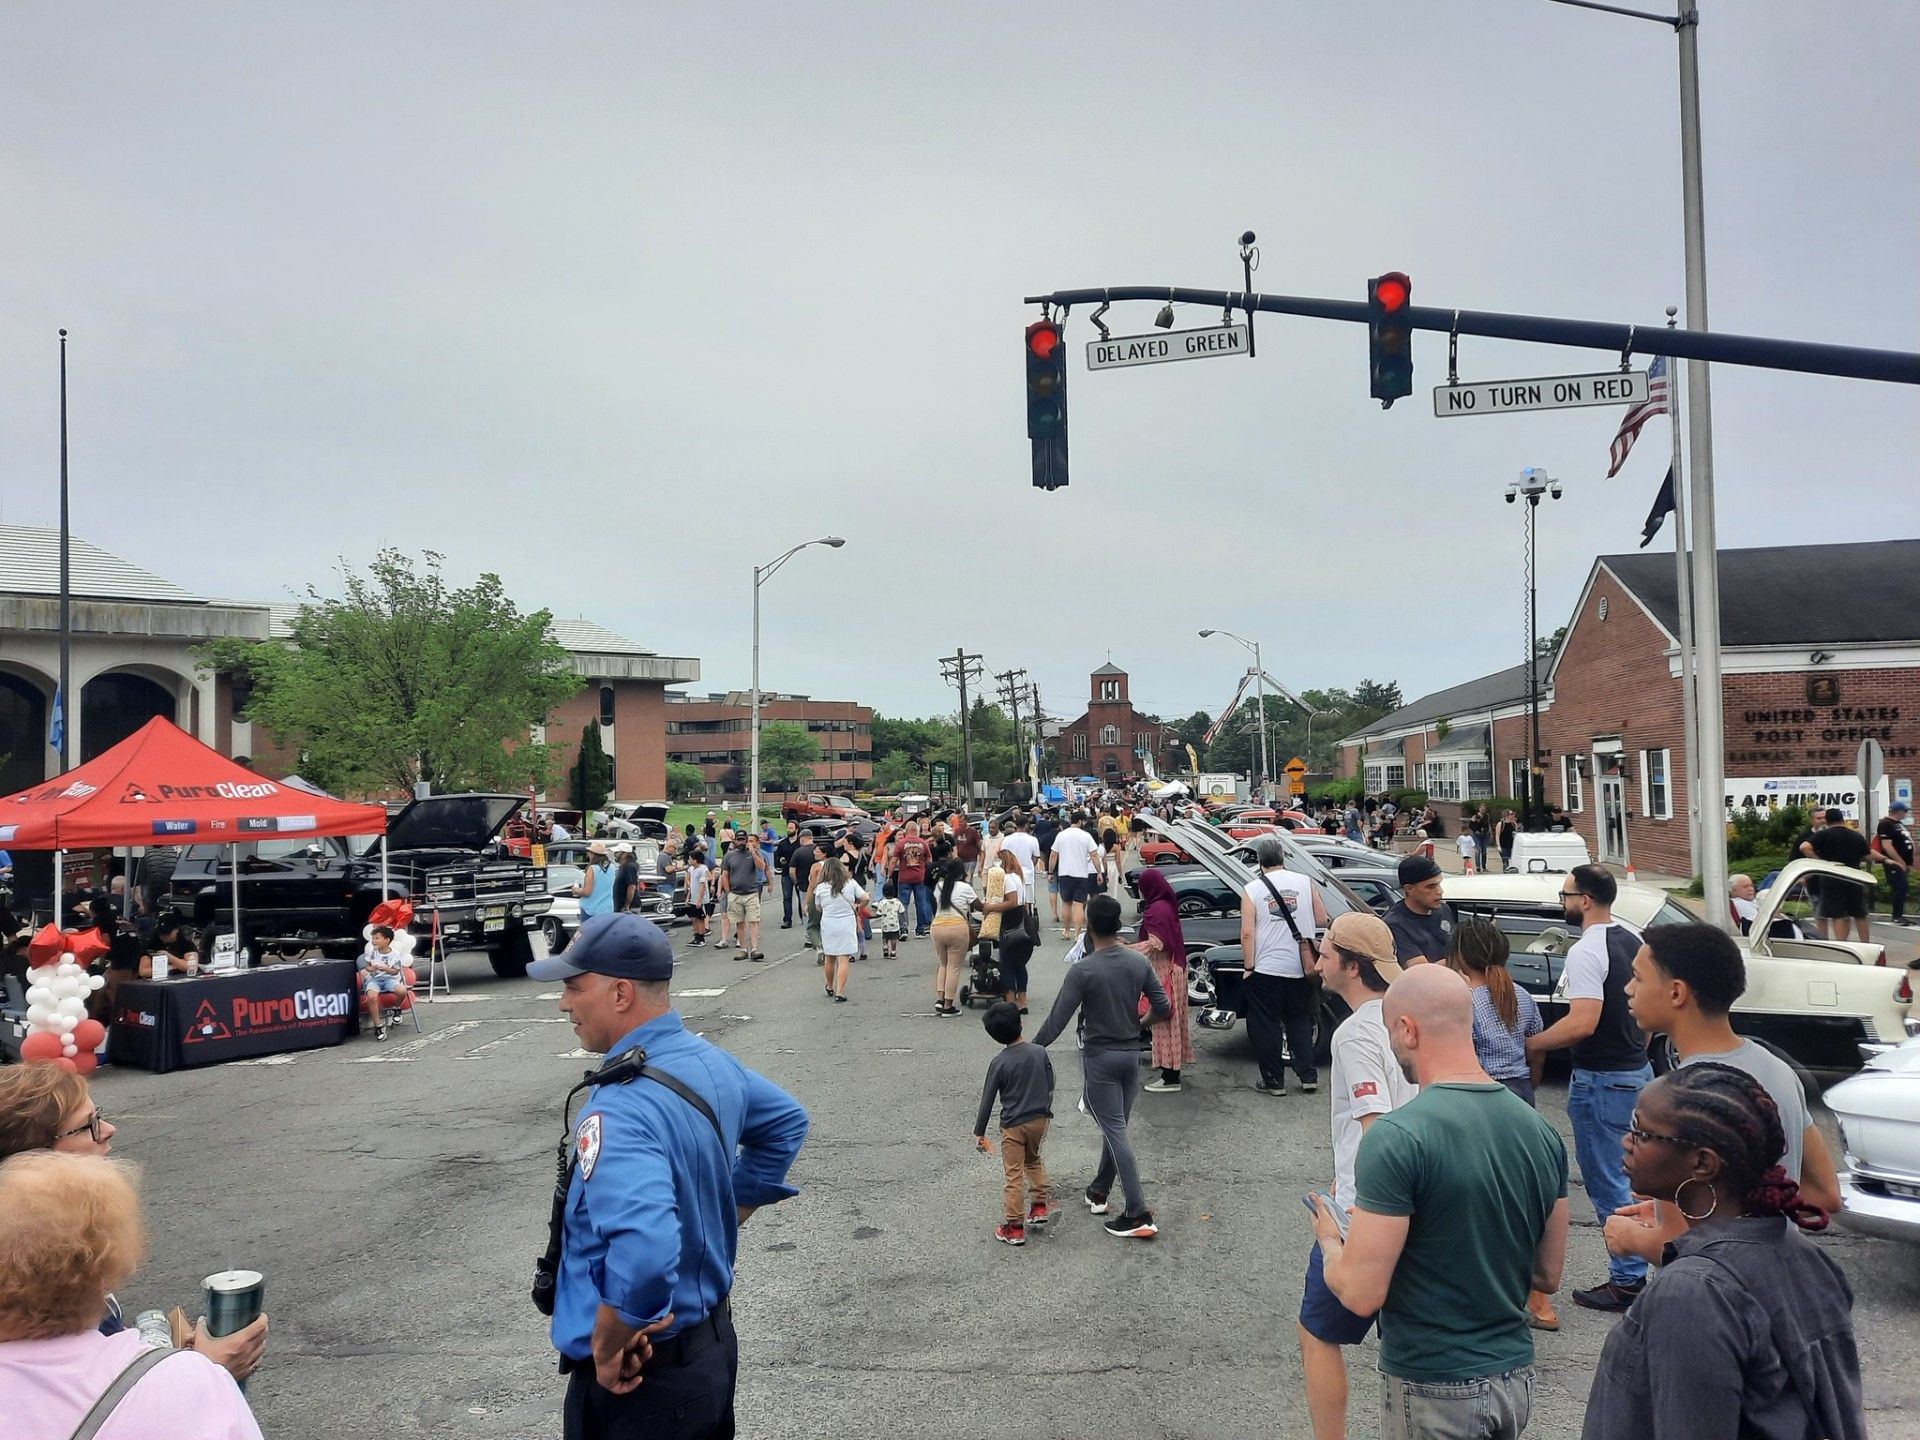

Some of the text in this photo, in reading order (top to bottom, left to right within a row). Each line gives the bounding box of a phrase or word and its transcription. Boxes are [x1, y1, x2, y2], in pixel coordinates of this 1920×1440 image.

[1097, 331, 1239, 363] DELAYED GREEN
[1450, 378, 1634, 410] NO TURN ON RED
[1745, 707, 1900, 724] UNITED STATES
[1754, 726, 1892, 743] POST OFFICE
[158, 780, 279, 799] PuroClean
[1725, 792, 1858, 808] E ARE HIRING
[165, 821, 188, 831] Water
[210, 819, 226, 829] Fire
[249, 818, 267, 828] Mold
[232, 988, 350, 1028] PuroClean
